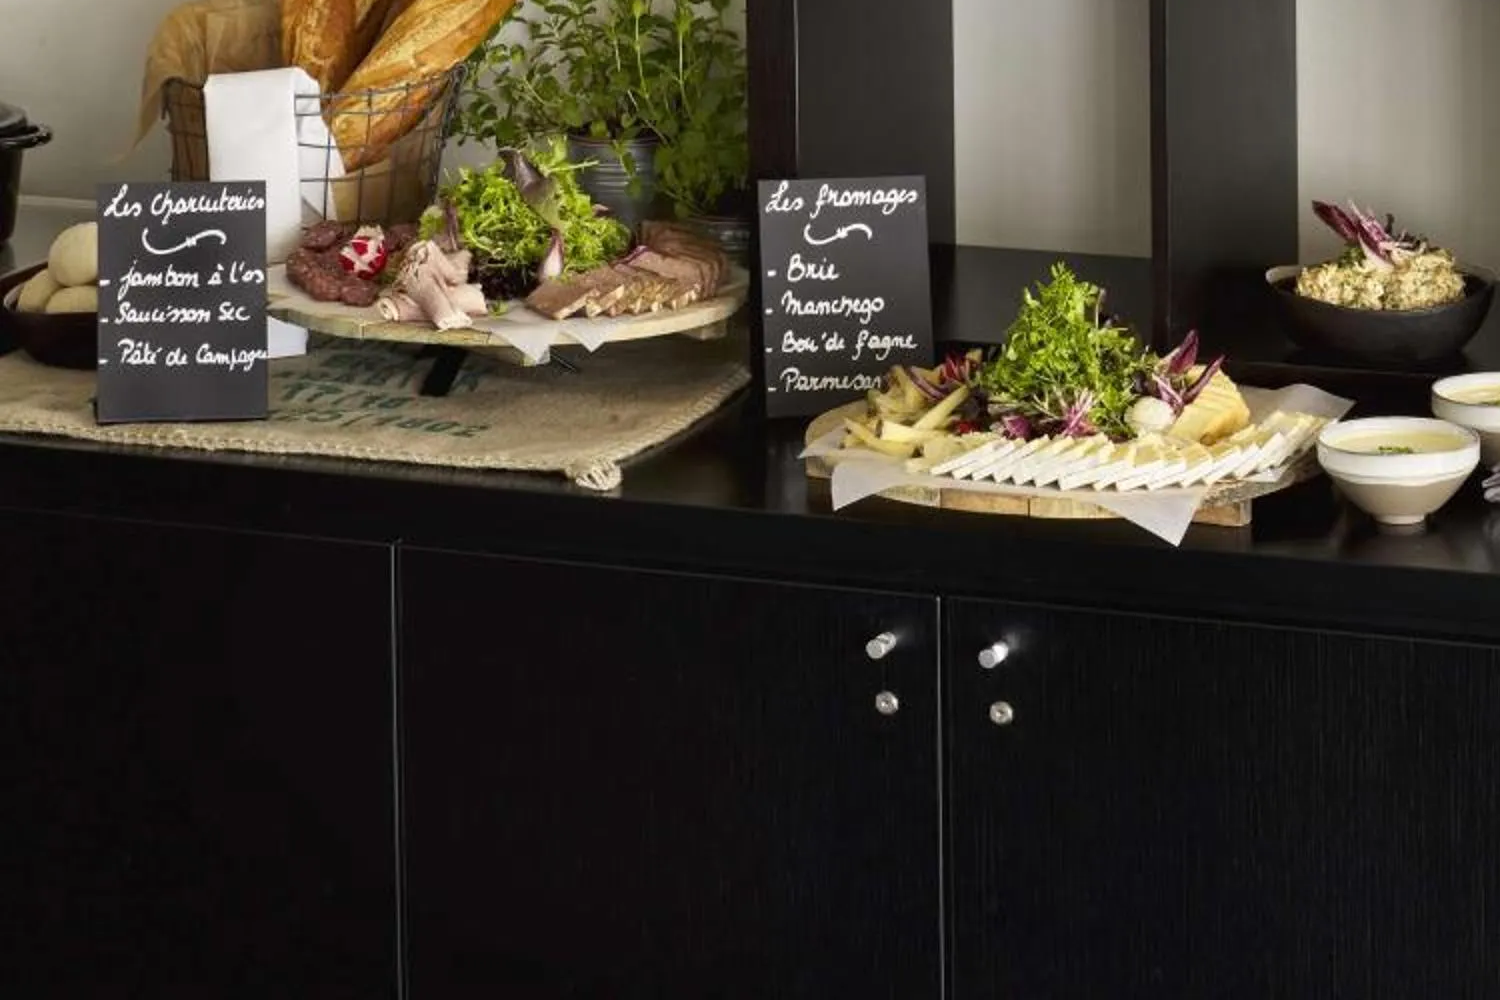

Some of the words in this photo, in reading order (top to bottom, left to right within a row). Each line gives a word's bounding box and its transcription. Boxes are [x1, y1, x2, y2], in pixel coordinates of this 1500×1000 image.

[103, 183, 143, 218] Les
[766, 179, 804, 213] Les
[809, 183, 919, 220] fromages
[786, 252, 840, 283] Brie
[165, 347, 188, 367] de
